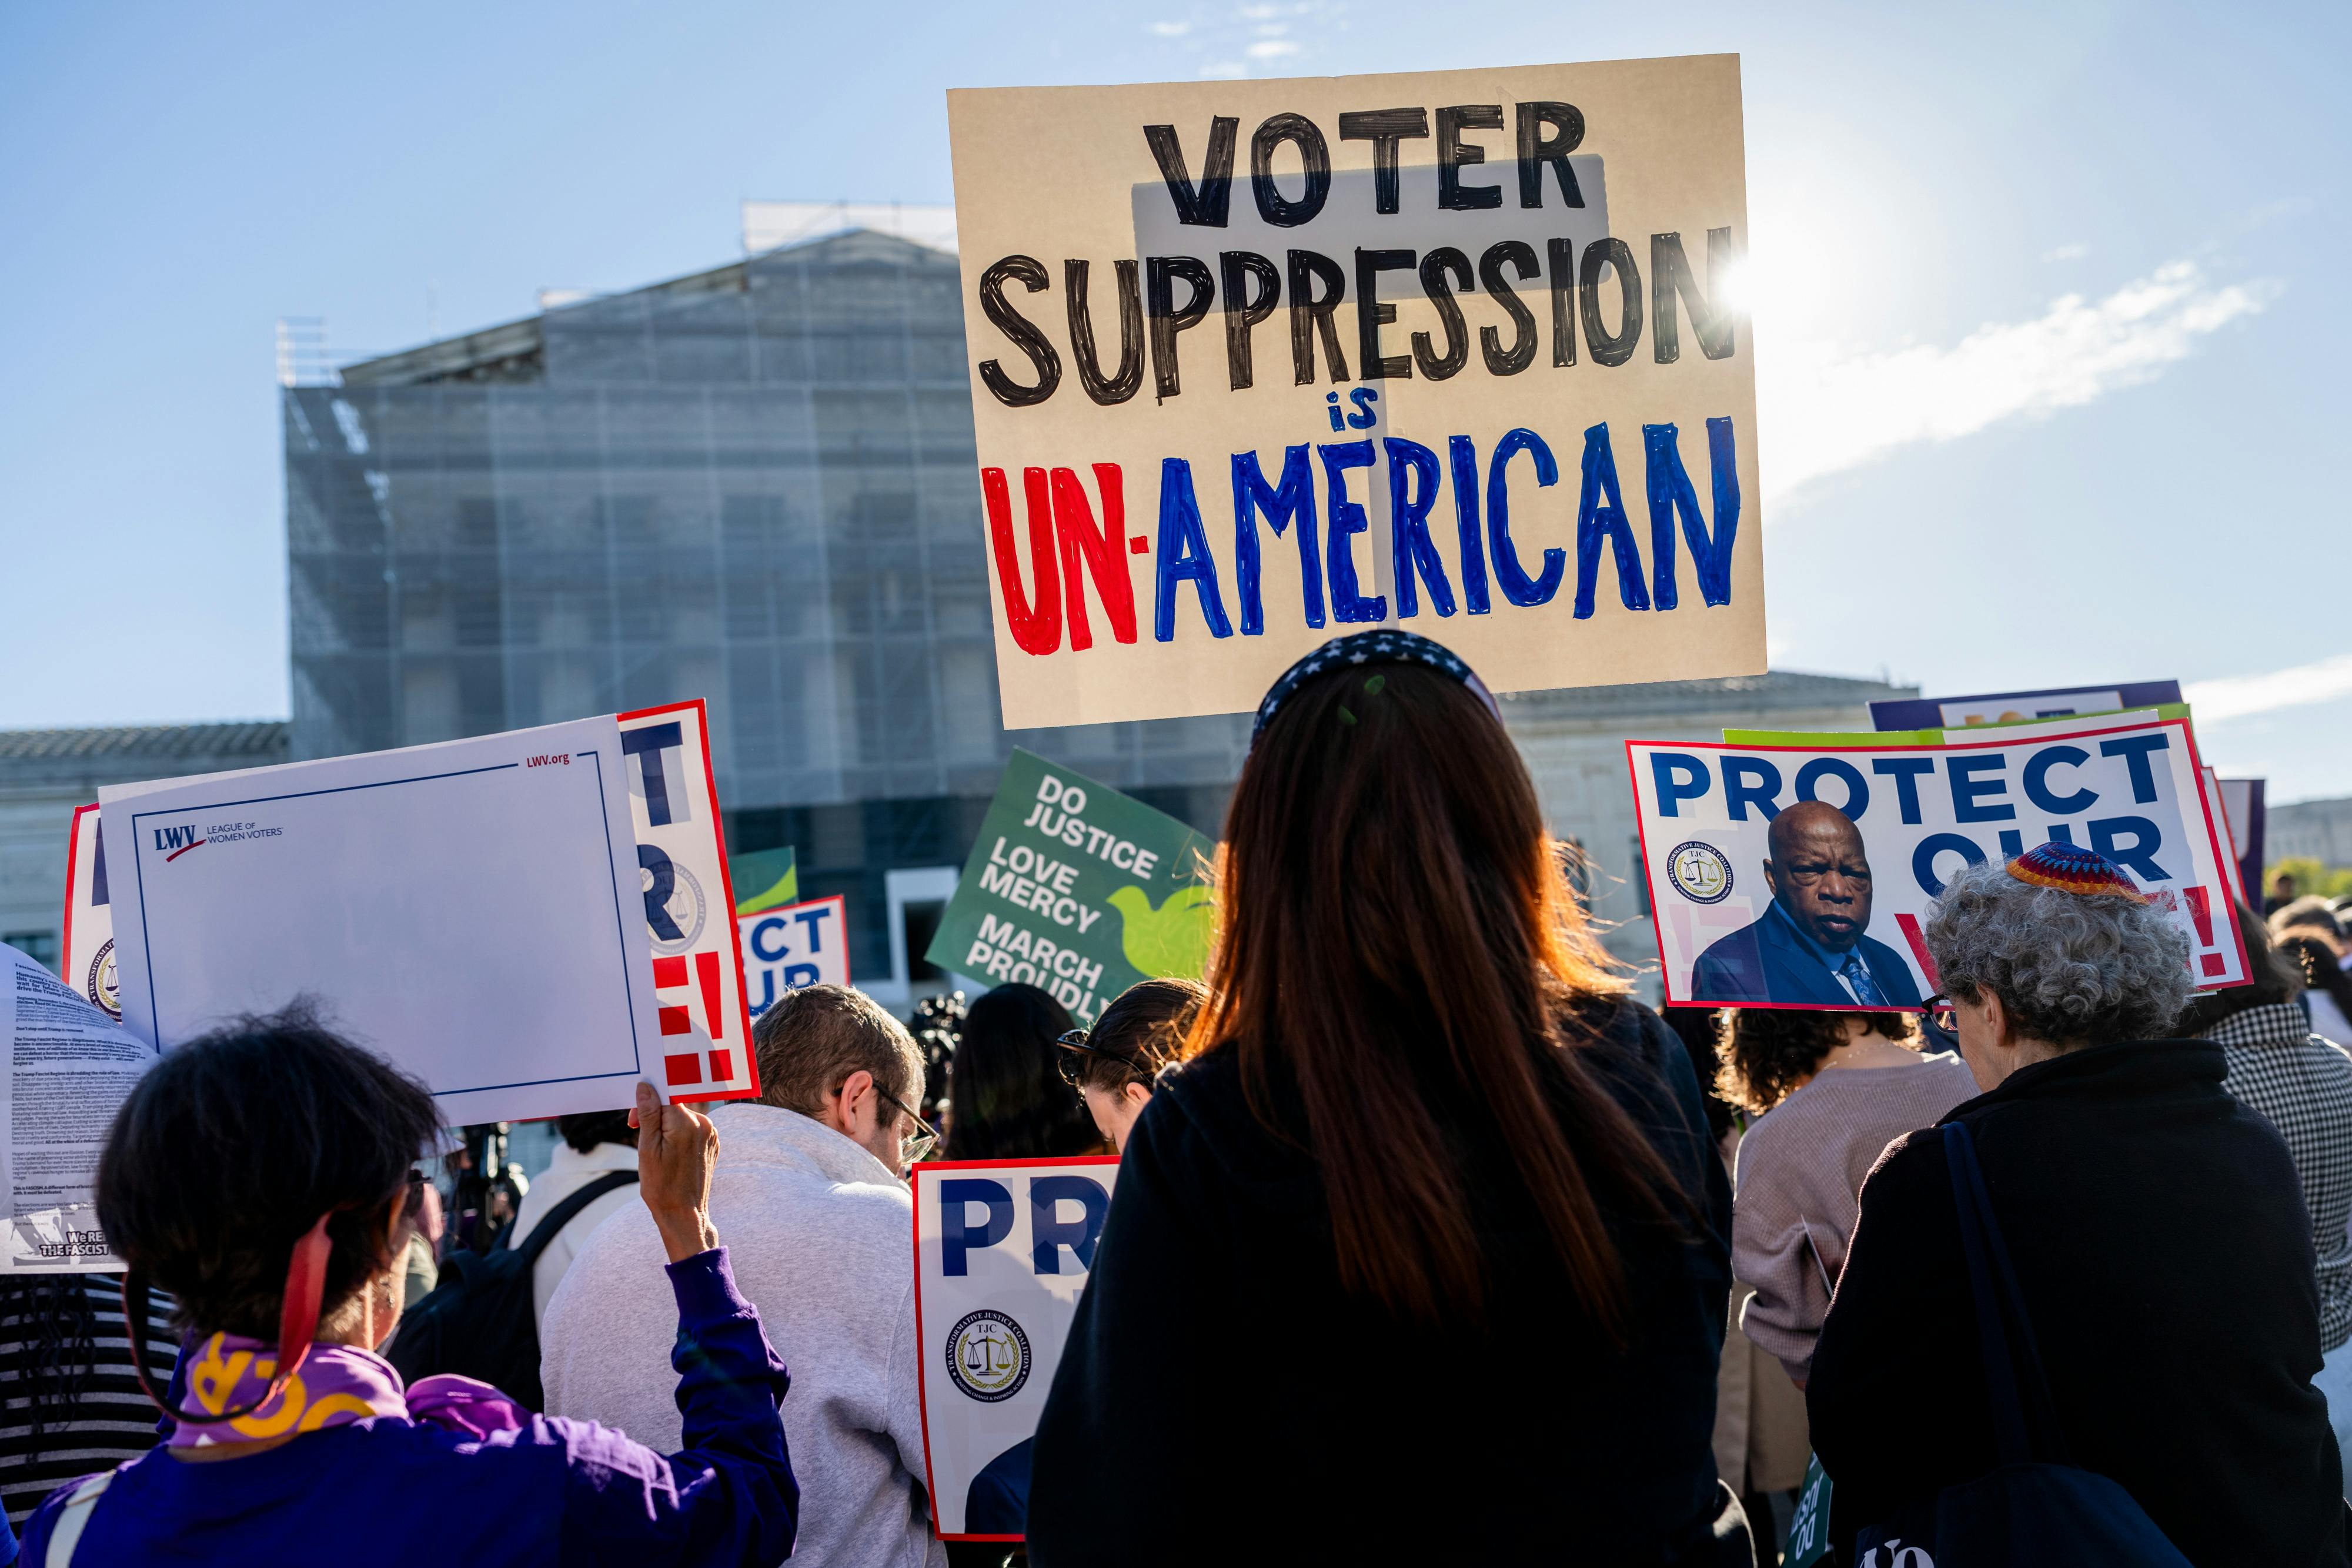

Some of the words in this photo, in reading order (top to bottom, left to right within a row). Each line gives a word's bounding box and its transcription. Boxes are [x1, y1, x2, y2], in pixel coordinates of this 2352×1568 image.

[1142, 100, 1586, 229] VOTER
[978, 225, 1738, 407] SUPPRESSION
[1327, 387, 1378, 433] is
[981, 415, 1740, 657] UN-AMERICAN
[527, 754, 570, 768] LWV.org
[1649, 733, 2170, 824] PROTECT
[1037, 774, 1087, 815] DO
[153, 824, 196, 850] LWV
[207, 823, 243, 834] LEAGUE
[208, 832, 245, 844] WOMEN
[246, 827, 283, 839] VOTERS
[1024, 803, 1159, 880] JUSTICE
[990, 836, 1080, 895] LOVE
[1668, 842, 1693, 881] TRANSFORMATIVE
[1693, 842, 1716, 855] JUSTICE
[1716, 853, 1732, 883] COALITION
[978, 864, 1102, 934] MERCY
[977, 912, 1103, 989] MARCH
[965, 940, 1110, 1022] PROUDL
[41, 1244, 64, 1257] THE
[65, 1243, 109, 1256] FASCIST
[66, 1231, 86, 1243] We
[947, 1312, 983, 1370] TRANSFORMATIVE
[984, 1312, 1013, 1328] JUSTICE
[1013, 1326, 1030, 1370] COALITION
[976, 1324, 997, 1333] TJC
[956, 1378, 971, 1395] IGNITING
[971, 1391, 990, 1400] CHANGE
[993, 1390, 1014, 1400] INSPIRING
[1013, 1377, 1025, 1392] ACTION
